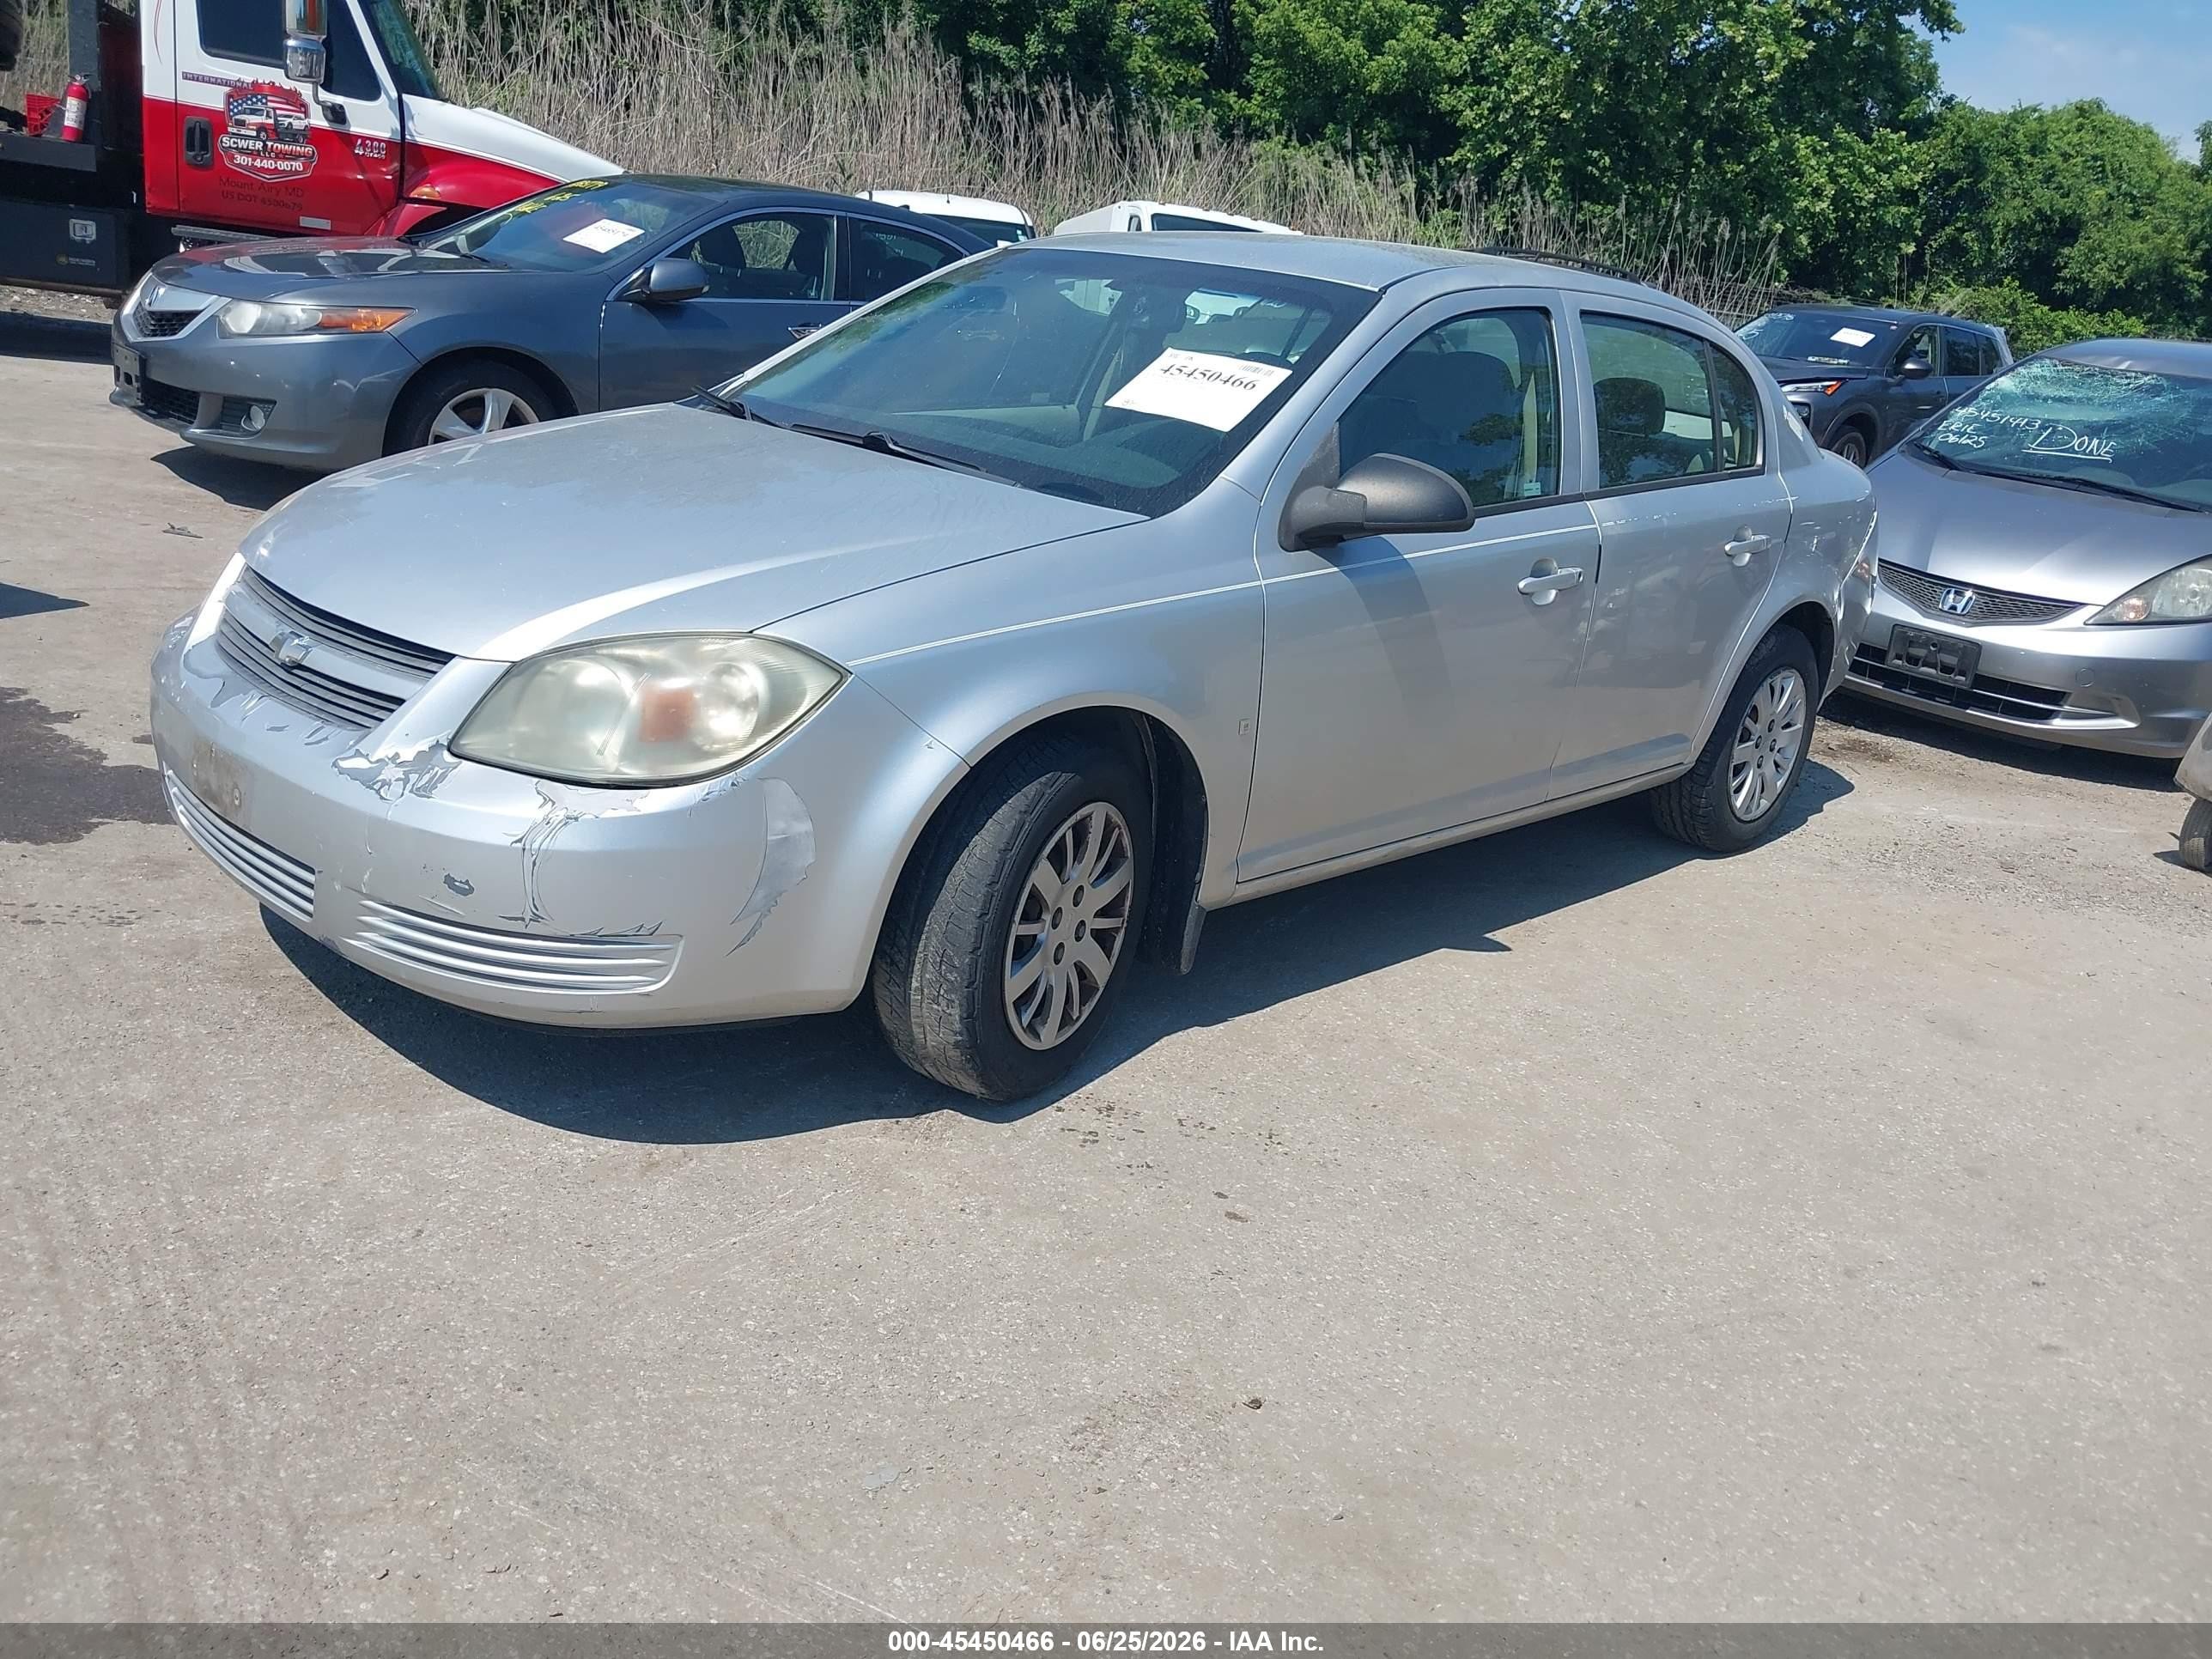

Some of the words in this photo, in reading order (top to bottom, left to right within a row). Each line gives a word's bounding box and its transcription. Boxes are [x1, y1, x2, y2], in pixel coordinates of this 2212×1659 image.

[182, 72, 253, 90] INTERNATIONAL
[222, 137, 263, 150] SCWER
[265, 142, 313, 157] TOWING
[355, 138, 386, 155] 4300
[234, 155, 303, 172] 301-440-0070
[220, 176, 254, 191] Mount
[258, 182, 280, 196] Airy
[285, 186, 304, 198] MD
[222, 190, 234, 199] US
[237, 192, 257, 203] DOT
[1160, 363, 1260, 391] 45450466
[1937, 420, 1984, 434] ERIE
[2027, 423, 2117, 458] DONE
